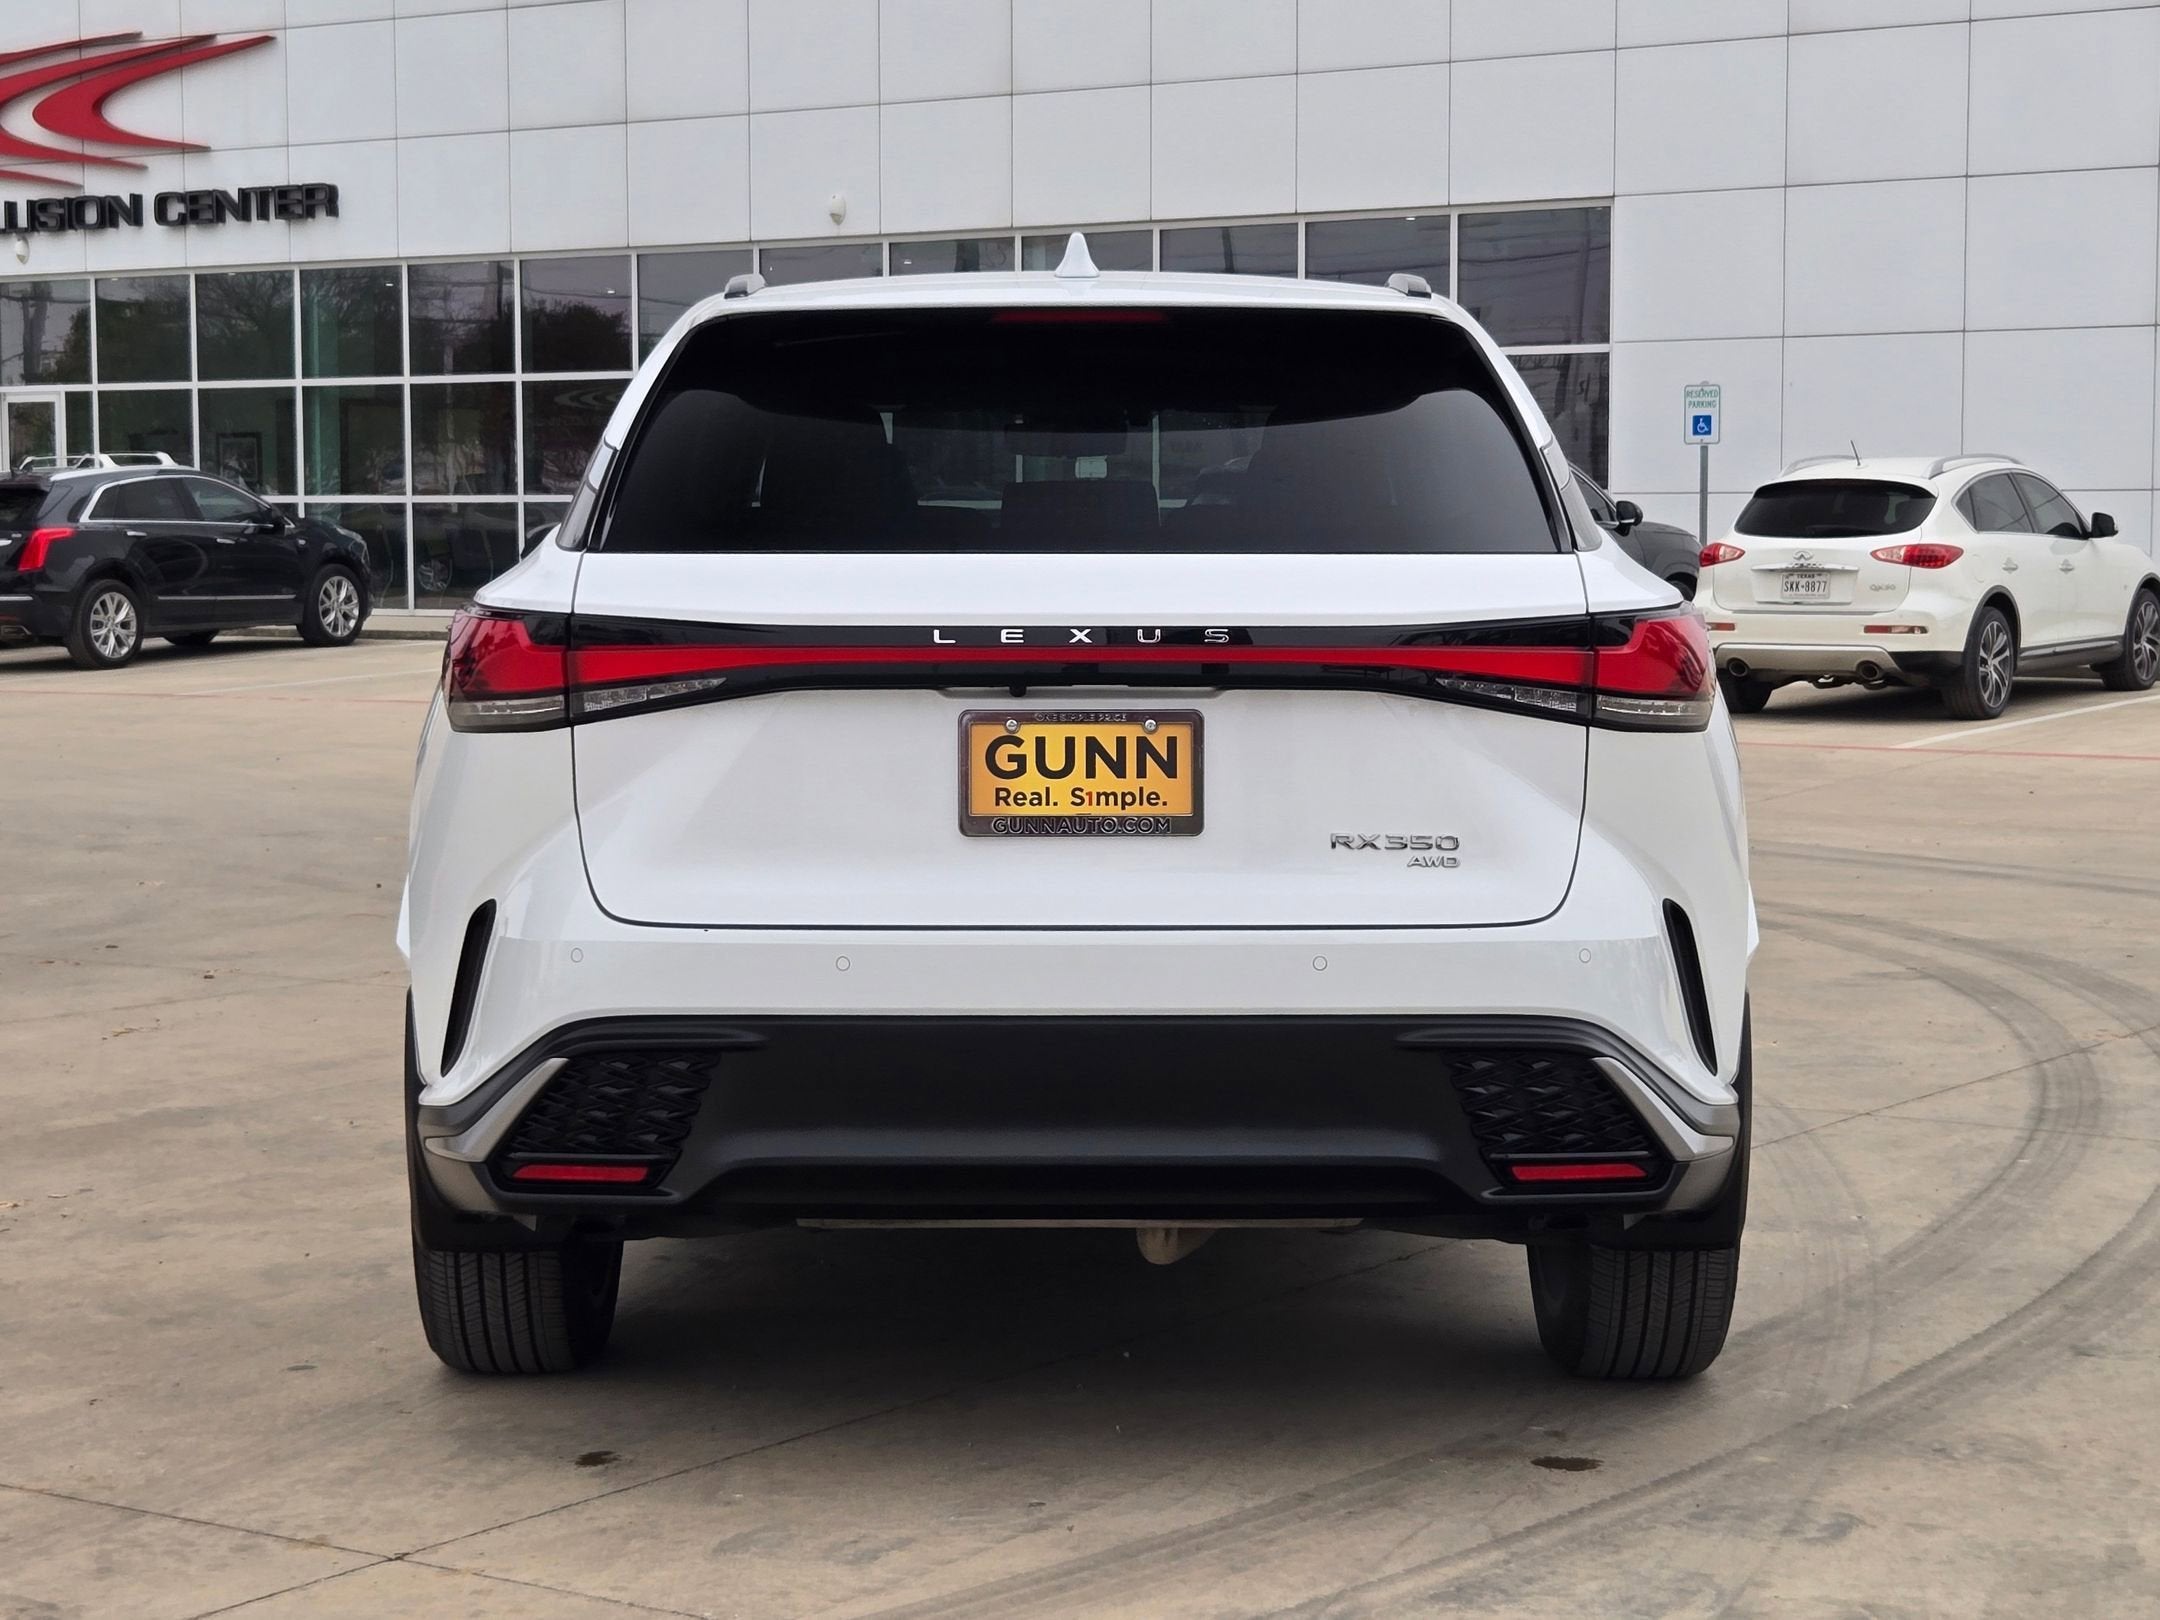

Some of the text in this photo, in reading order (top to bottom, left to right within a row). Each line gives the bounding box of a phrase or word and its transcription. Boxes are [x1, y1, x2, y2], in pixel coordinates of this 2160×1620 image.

[0, 183, 339, 233] LISION CENTER
[1686, 390, 1718, 398] RESERVED
[1688, 400, 1717, 408] PARKING
[933, 628, 1230, 644] LEXUS
[985, 734, 1178, 780] GUNN
[994, 787, 1058, 807] Real.
[992, 816, 1171, 834] GUNNAUTO.COM
[1406, 856, 1461, 868] AWD
